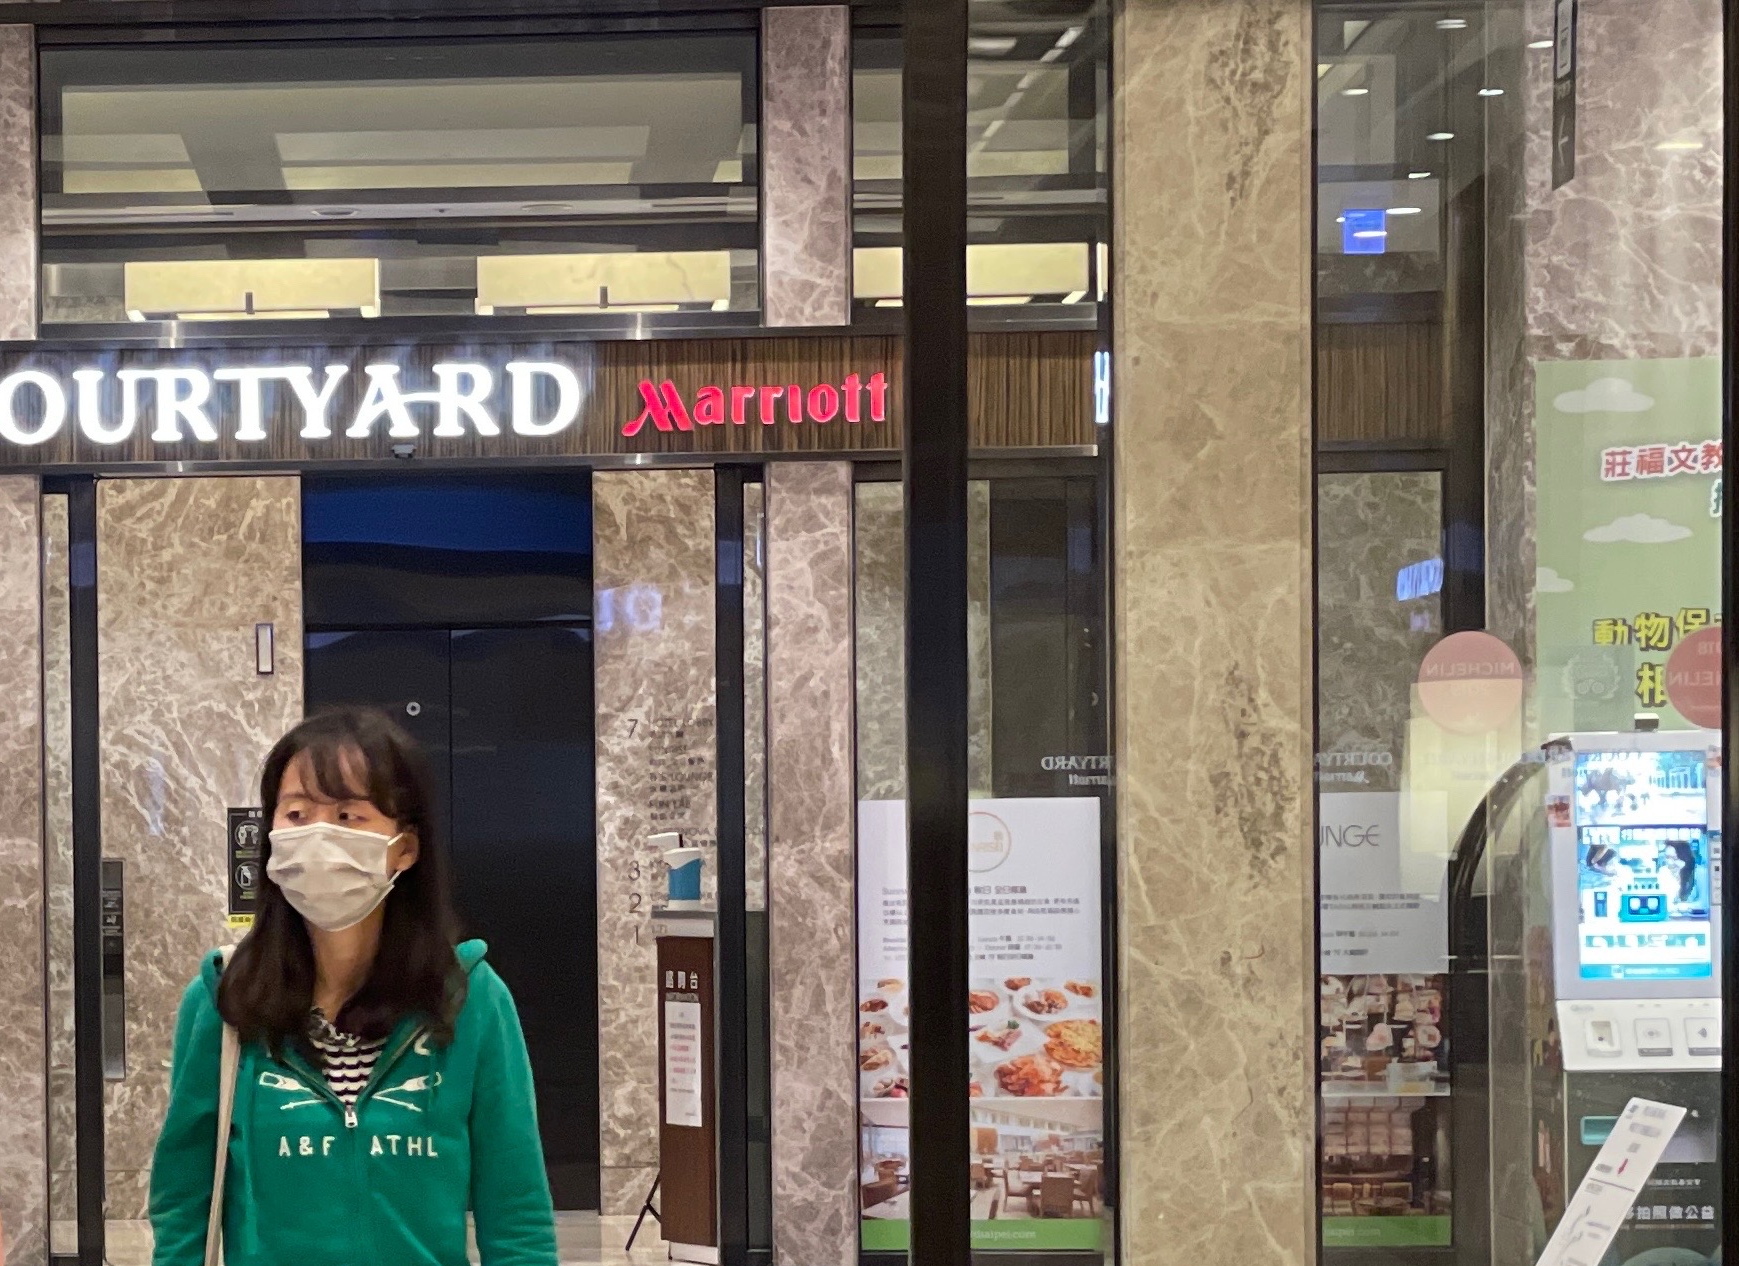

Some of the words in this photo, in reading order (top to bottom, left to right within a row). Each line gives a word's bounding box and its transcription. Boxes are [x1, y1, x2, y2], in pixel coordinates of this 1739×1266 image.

[621, 372, 888, 437] Marriott
[1593, 607, 1722, 651] 動物保
[628, 719, 638, 738] 7
[628, 861, 640, 880] 3
[629, 893, 641, 913] 2
[370, 1135, 438, 1157] ATHL
